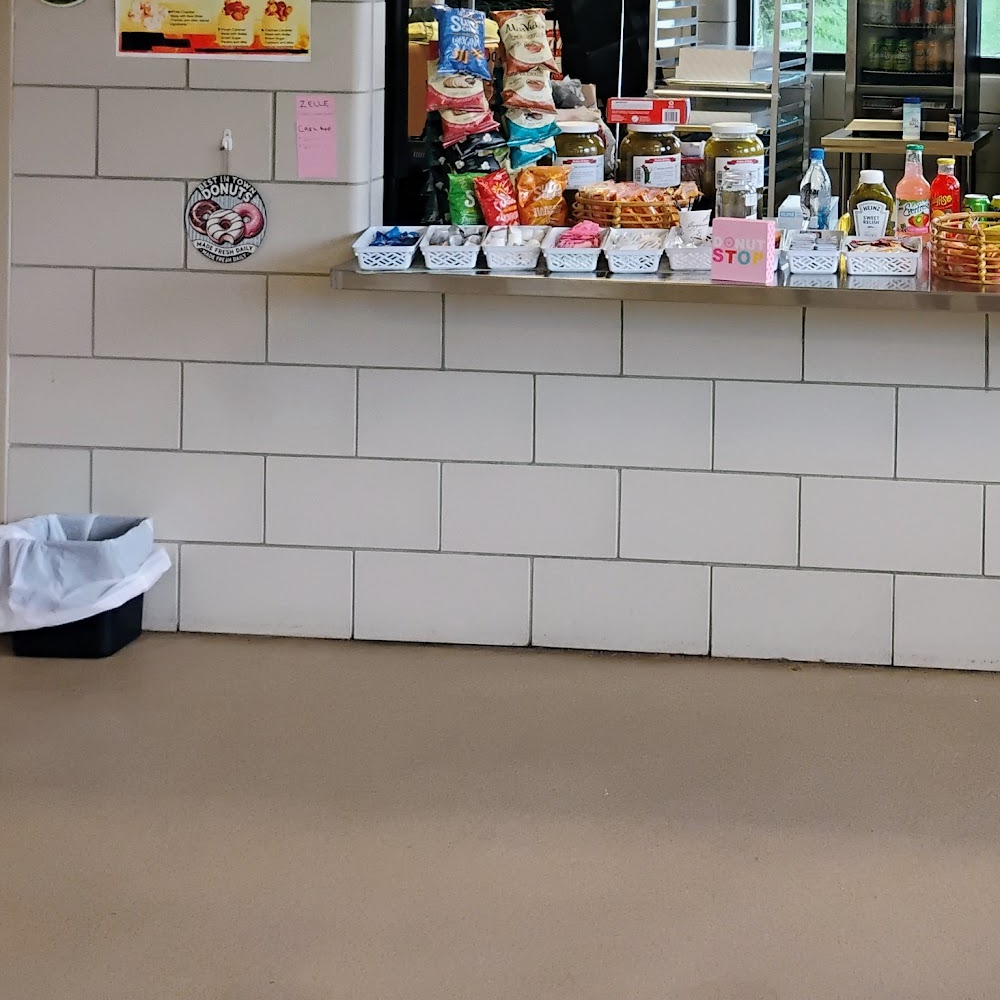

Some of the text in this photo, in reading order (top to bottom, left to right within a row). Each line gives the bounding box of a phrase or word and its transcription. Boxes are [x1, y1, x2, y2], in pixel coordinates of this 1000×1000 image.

[300, 100, 329, 108] ZELLE
[198, 176, 217, 190] BEST
[232, 176, 257, 194] TOWN
[201, 183, 253, 202] DONUTS
[196, 241, 213, 250] MADE
[236, 245, 254, 253] DAILY
[712, 237, 766, 250] DONUT
[712, 248, 764, 265] STOP
